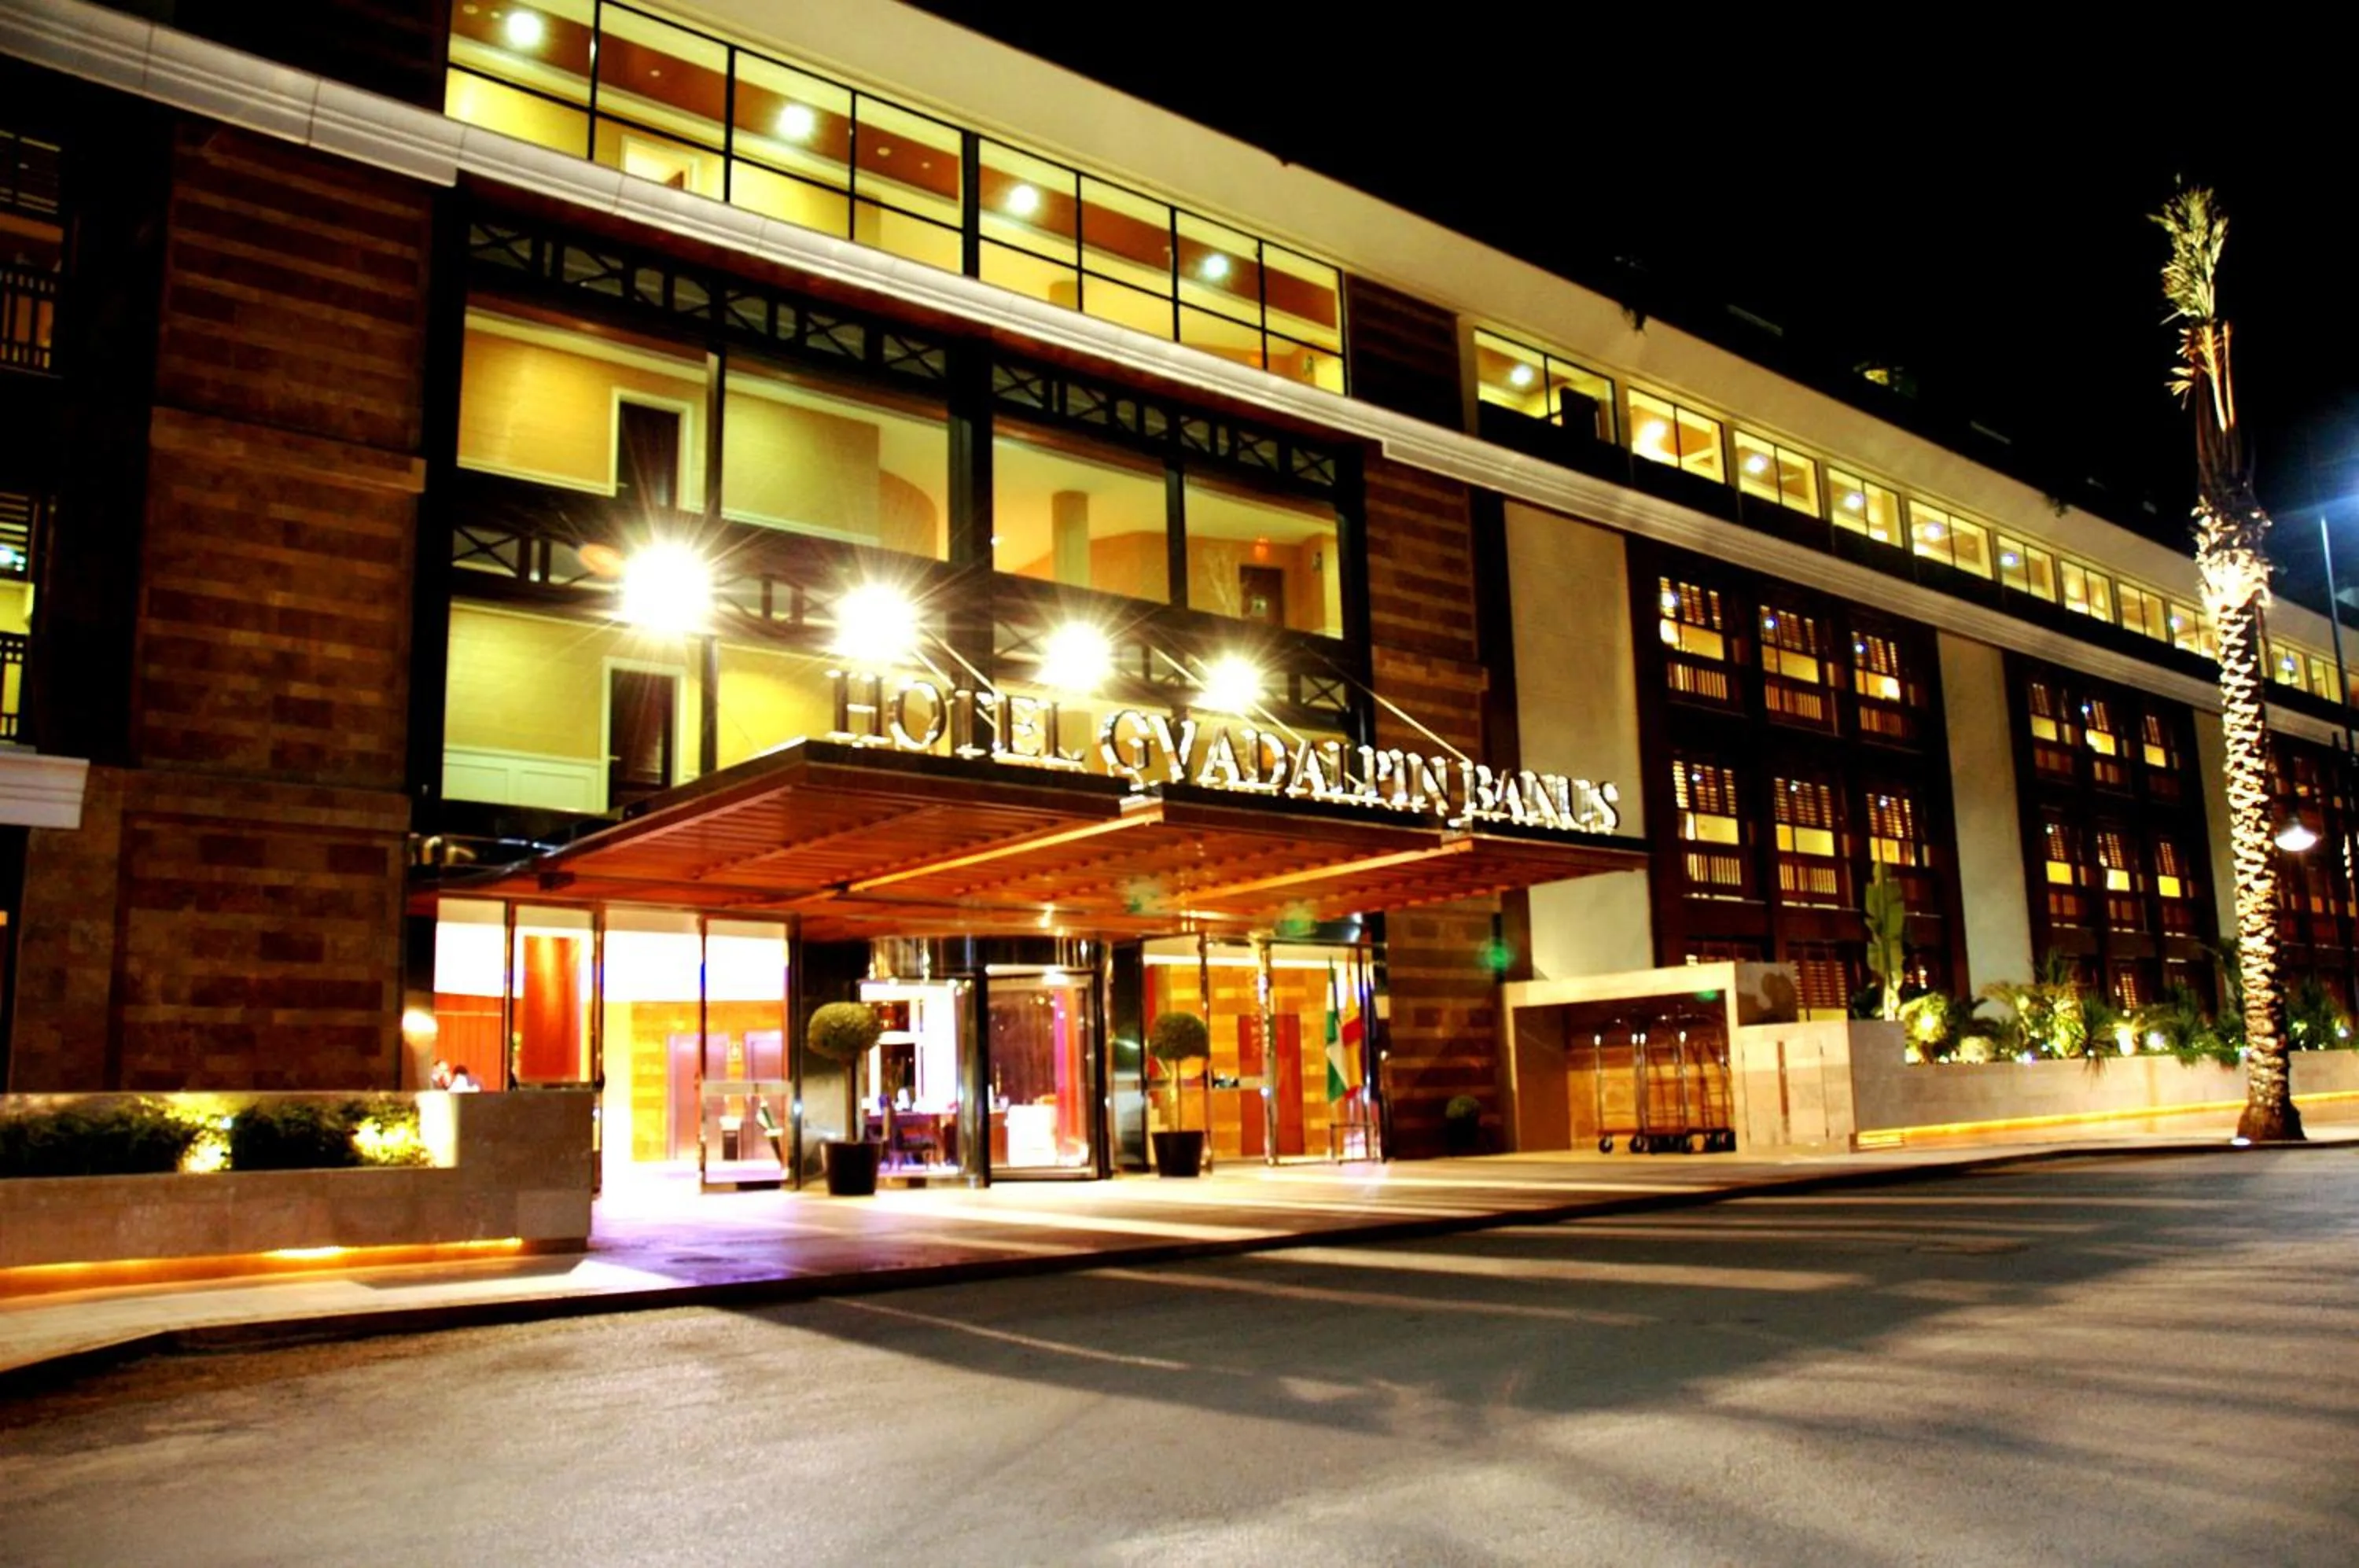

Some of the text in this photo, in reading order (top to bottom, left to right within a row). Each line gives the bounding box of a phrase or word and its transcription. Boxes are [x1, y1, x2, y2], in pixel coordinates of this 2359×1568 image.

[826, 669, 1621, 835] HOTEL GVADALPIN BANUS
